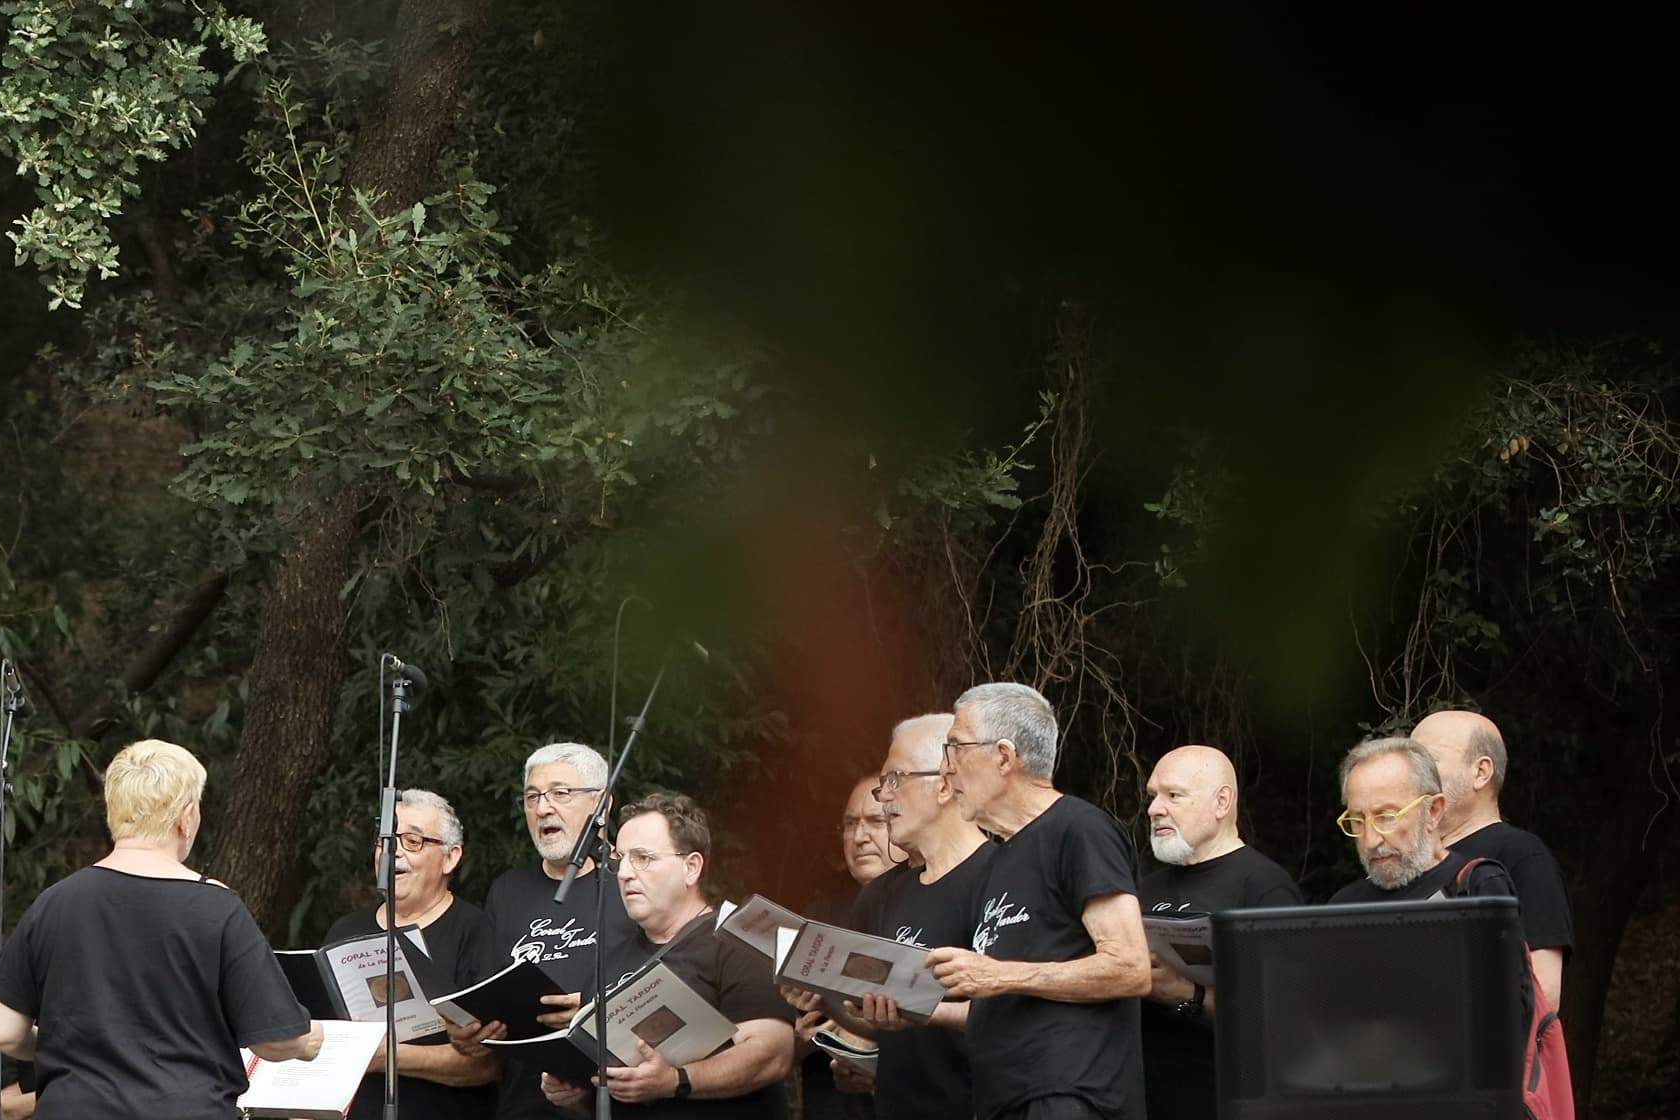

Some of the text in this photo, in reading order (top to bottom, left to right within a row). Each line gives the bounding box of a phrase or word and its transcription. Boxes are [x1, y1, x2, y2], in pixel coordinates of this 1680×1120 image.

[529, 918, 576, 938] Coral
[340, 951, 372, 965] CORAL
[627, 977, 662, 1004] TARDOR
